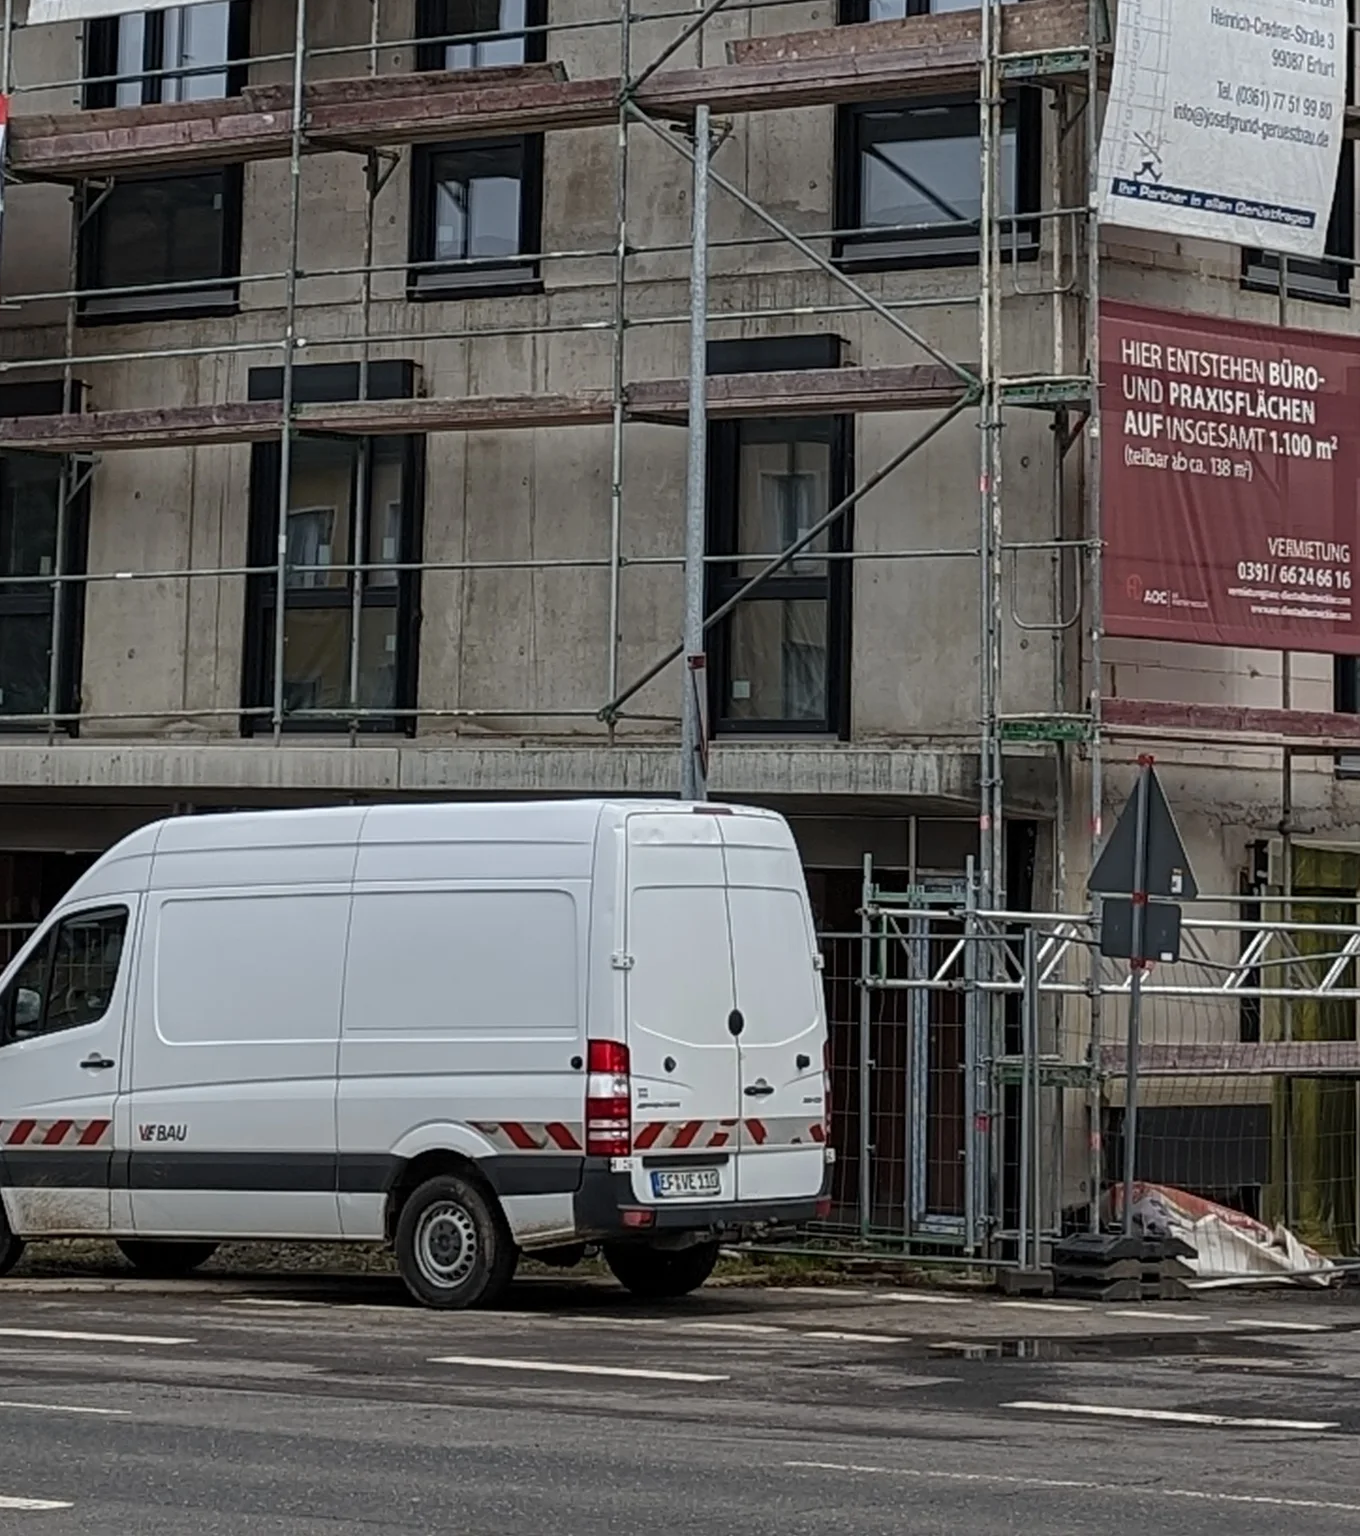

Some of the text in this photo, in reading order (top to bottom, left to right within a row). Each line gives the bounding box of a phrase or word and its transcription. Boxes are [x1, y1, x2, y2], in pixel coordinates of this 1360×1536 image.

[1328, 32, 1334, 50] 3
[1272, 48, 1335, 77] 99087 Erfurt
[1217, 80, 1332, 120] Tel. (0361) 77 51 99 80
[1139, 184, 1188, 204] Partner
[1190, 194, 1202, 206] in
[1122, 339, 1326, 391] HIER ENTSTEHEN BÜRO-
[1123, 375, 1315, 424] UND PRAXISFLÄCHEN
[1124, 410, 1163, 439] AUF
[1167, 415, 1265, 452] INSGESAMT
[1269, 431, 1312, 457] 1.100
[1124, 444, 1168, 469] (teilbar
[1172, 454, 1188, 471] ab
[1190, 457, 1207, 474] ca.
[1211, 456, 1231, 476] 138
[1268, 537, 1351, 563] VERMIETUNG
[1279, 566, 1296, 584] 66
[1298, 568, 1314, 585] 24
[1316, 569, 1333, 587] 66
[1335, 570, 1351, 589] 16
[157, 1124, 187, 1141] BAU
